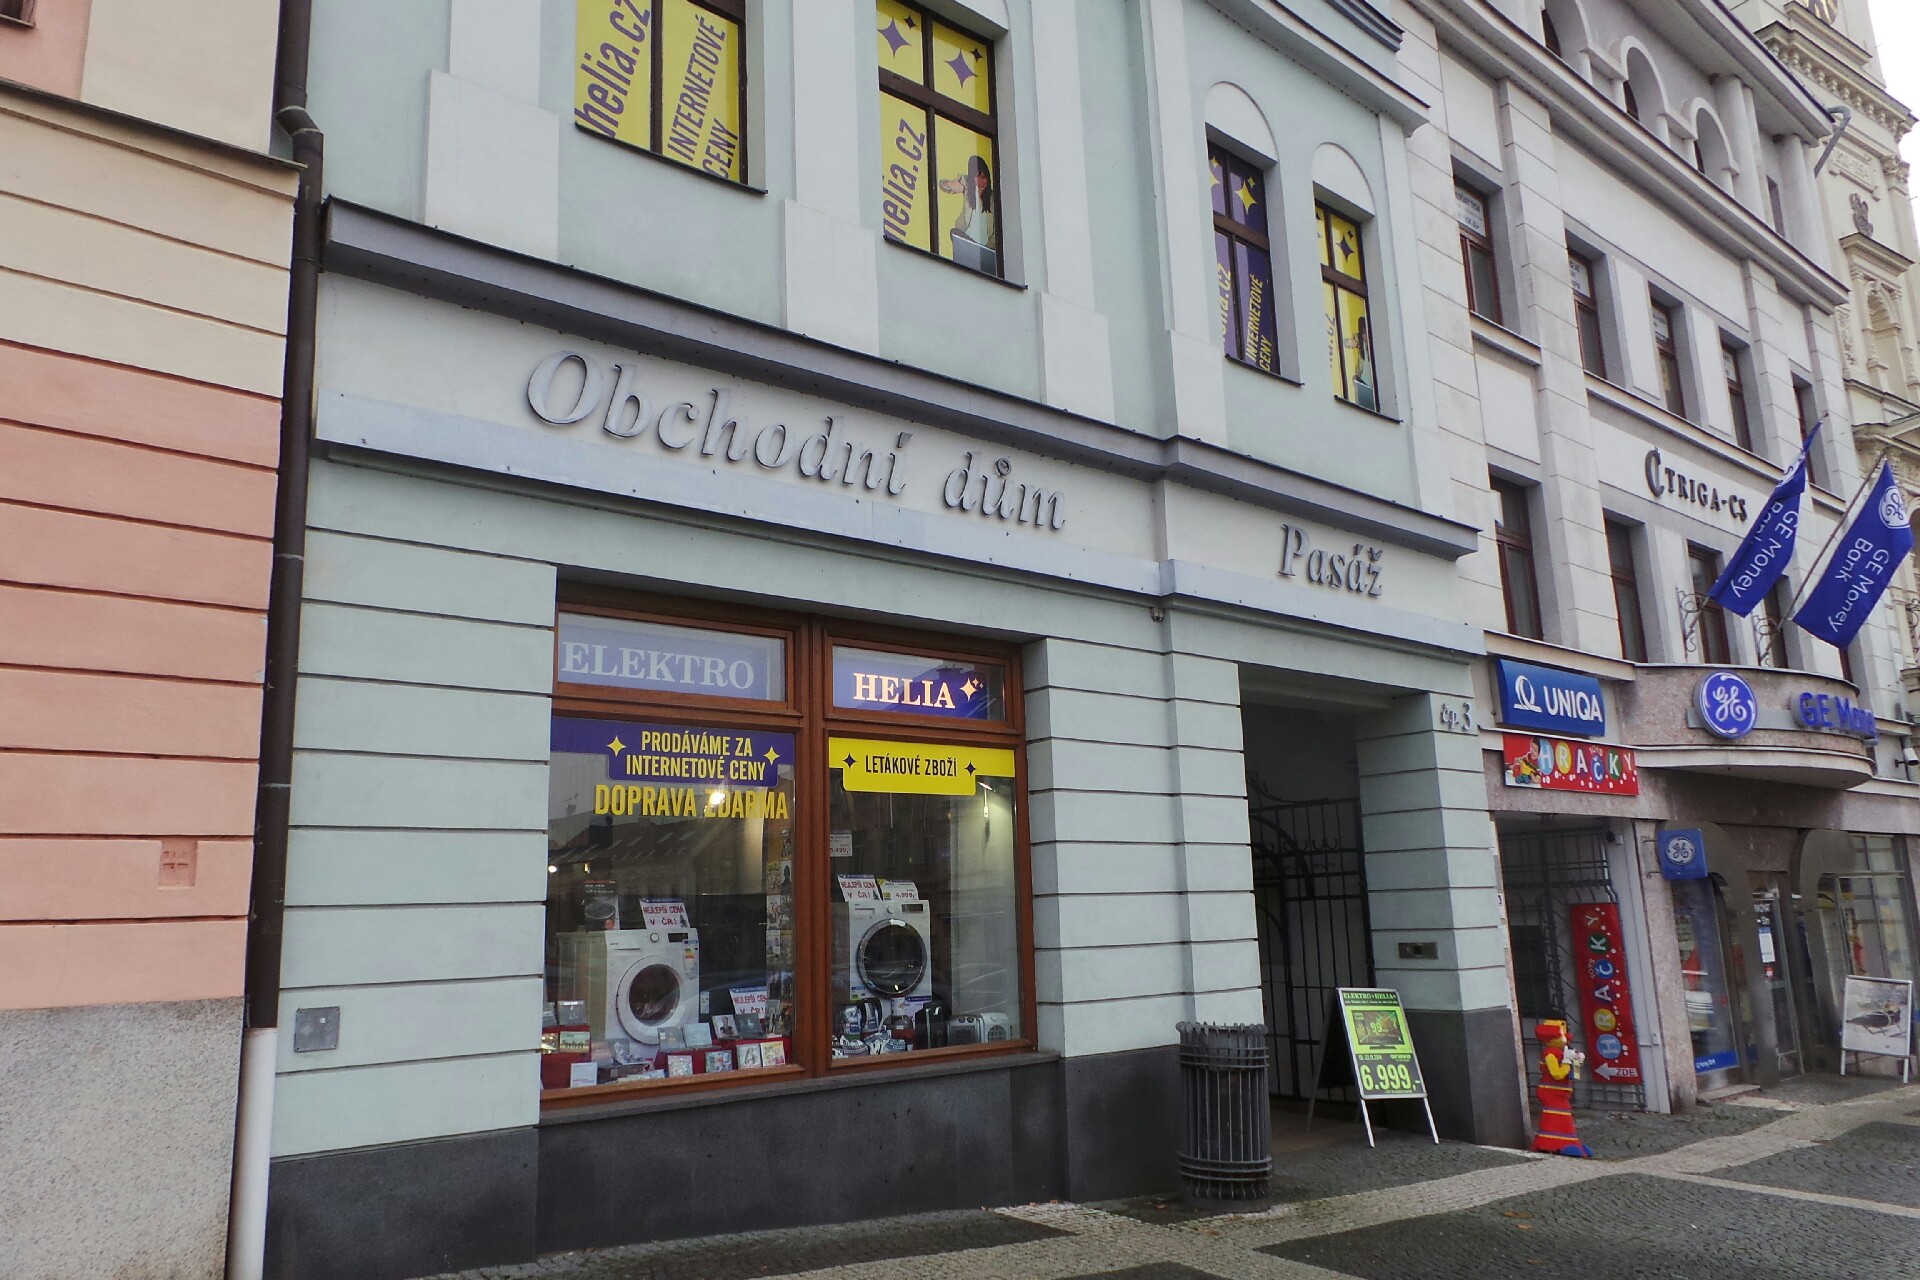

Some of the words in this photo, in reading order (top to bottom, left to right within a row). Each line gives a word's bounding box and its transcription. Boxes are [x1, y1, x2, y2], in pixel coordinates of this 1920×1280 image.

[574, 0, 651, 139] helia.cz
[667, 13, 726, 162] INTERNETOVÉ
[702, 118, 738, 180] CENY
[1246, 273, 1263, 363] INTERNETOVÉ
[1259, 335, 1272, 372] CENY
[527, 350, 914, 497] Obchodní
[943, 450, 1067, 532] dům
[1774, 510, 1799, 540] GE
[1277, 523, 1384, 598] Pasáž
[1730, 538, 1782, 598] Money
[1835, 537, 1874, 582] Bank
[1865, 548, 1890, 575] GE
[1828, 574, 1875, 633] Money
[561, 641, 755, 690] ELEKTRO
[853, 672, 956, 709] HELIA
[1543, 685, 1603, 722] UNIQA
[1462, 702, 1471, 731] 3
[1800, 692, 1833, 727] GE
[641, 730, 731, 756] PRODÁVÁME
[735, 737, 753, 757] ZA
[626, 754, 725, 779] INTERNETOVÉ
[729, 762, 766, 781] CENY
[865, 753, 921, 776] LETÁKOVÉ
[924, 757, 957, 778] ZBOŽÍ
[1540, 744, 1632, 781] HRAČKY
[595, 784, 697, 817] DOPRAVA
[704, 789, 789, 820] ZDARMA
[642, 904, 668, 915] NEJLEPŠÍ
[649, 918, 655, 926] V
[1586, 914, 1620, 1054] HRAČKY
[1360, 1064, 1421, 1091] 6.999,-
[1616, 1067, 1636, 1077] ZDE
